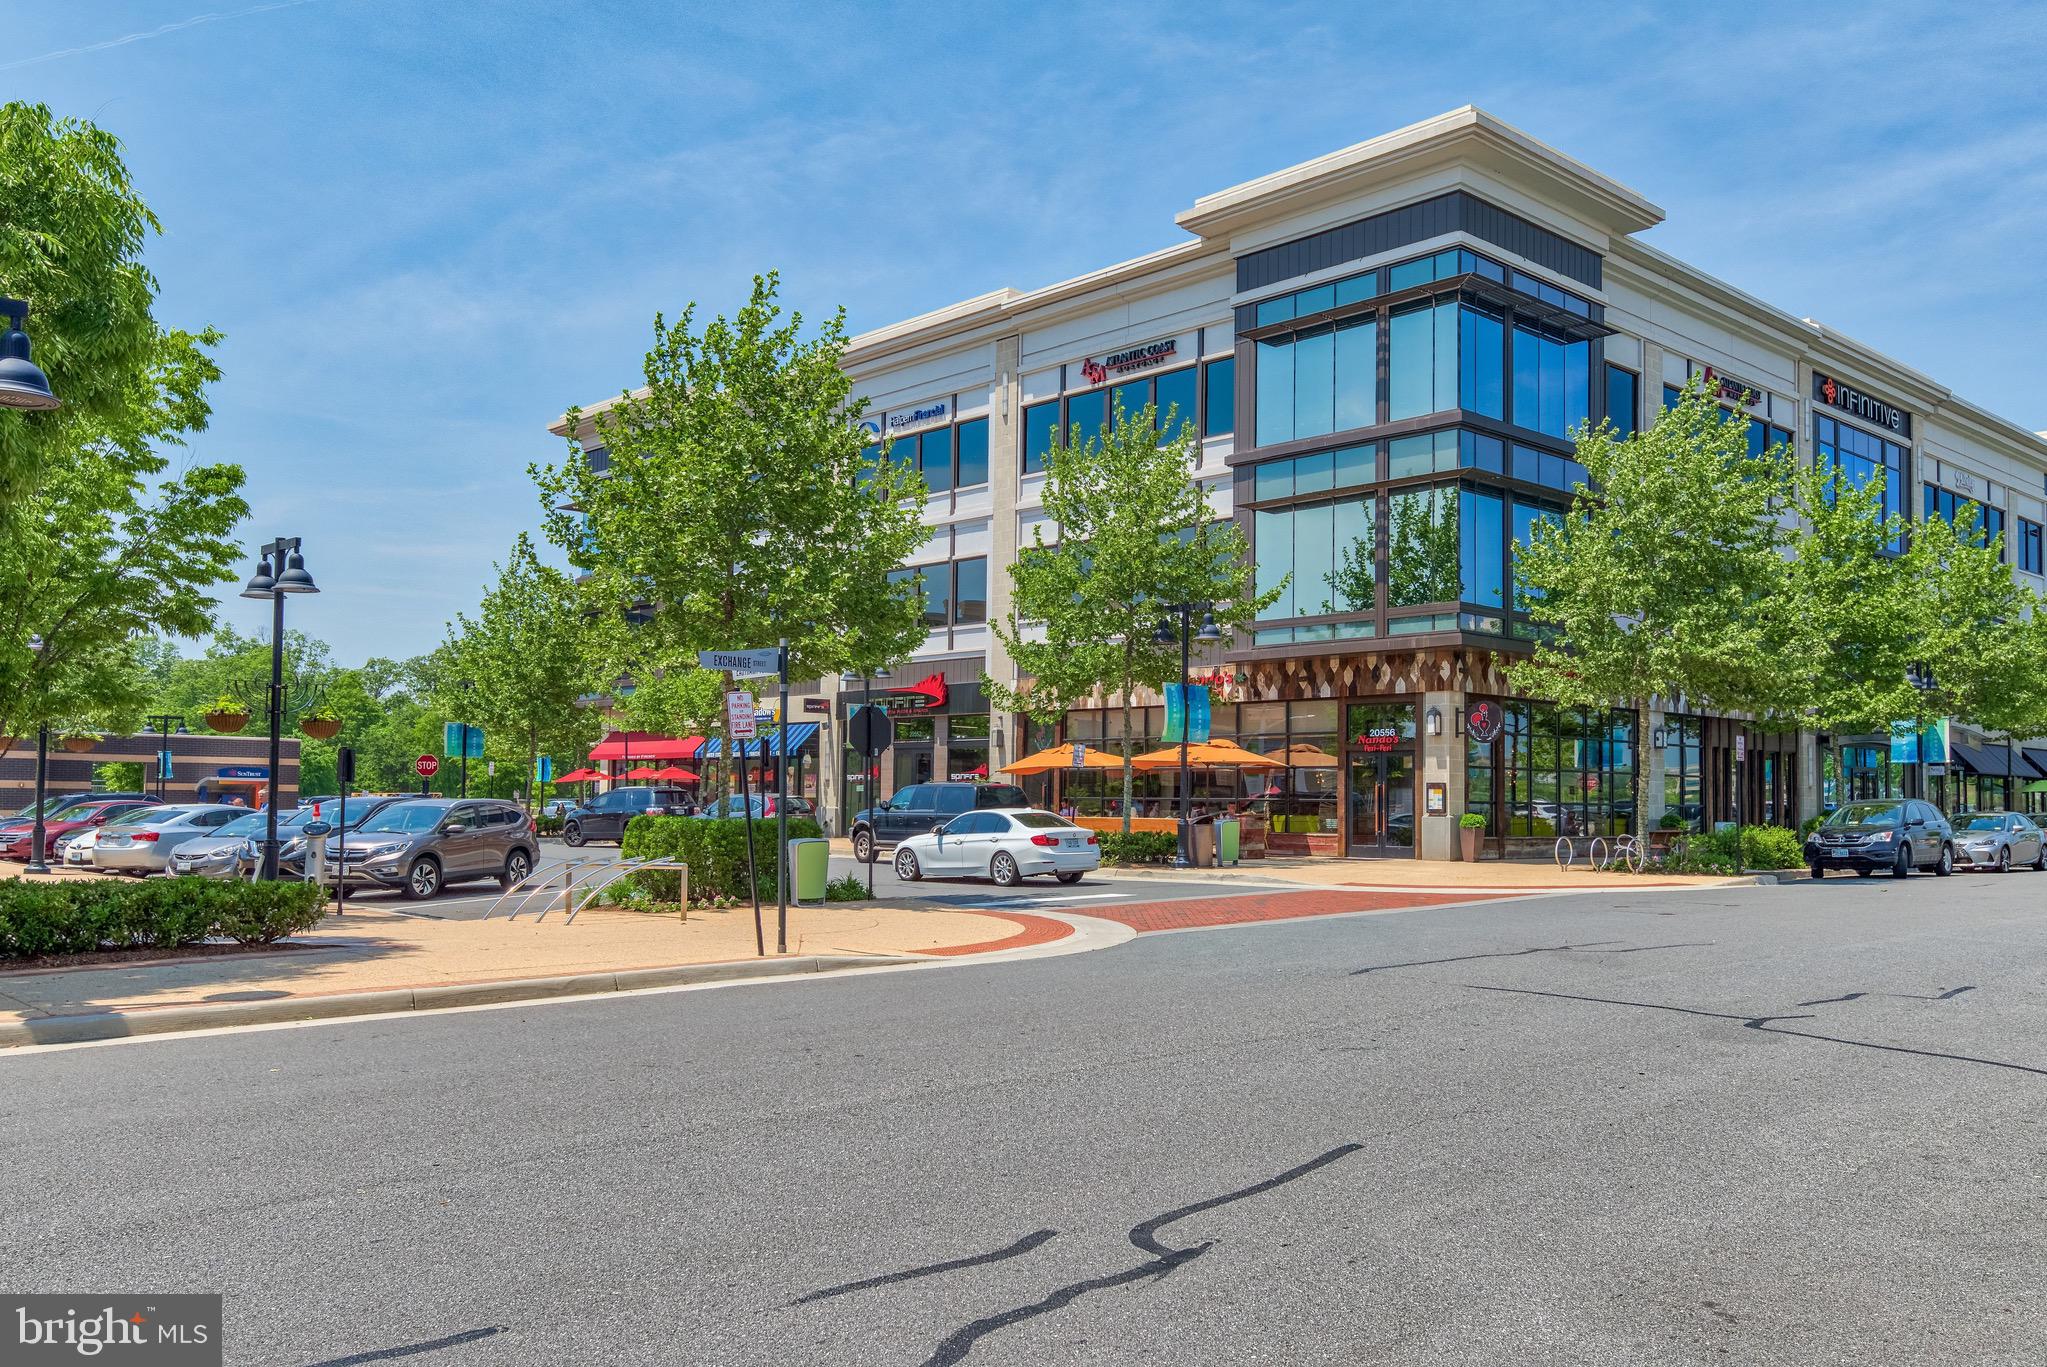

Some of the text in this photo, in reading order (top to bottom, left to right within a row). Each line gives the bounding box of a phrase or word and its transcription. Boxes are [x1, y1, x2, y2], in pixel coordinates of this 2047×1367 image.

[1106, 340, 1176, 367] ATLANTIC COAST
[713, 655, 751, 669] EXCHANGE
[731, 721, 753, 729] FIRE LANE
[1369, 728, 1396, 737] 20556
[1357, 735, 1399, 745] Nando's
[1363, 744, 1393, 752] Peri-Peri
[417, 761, 437, 770] STOP
